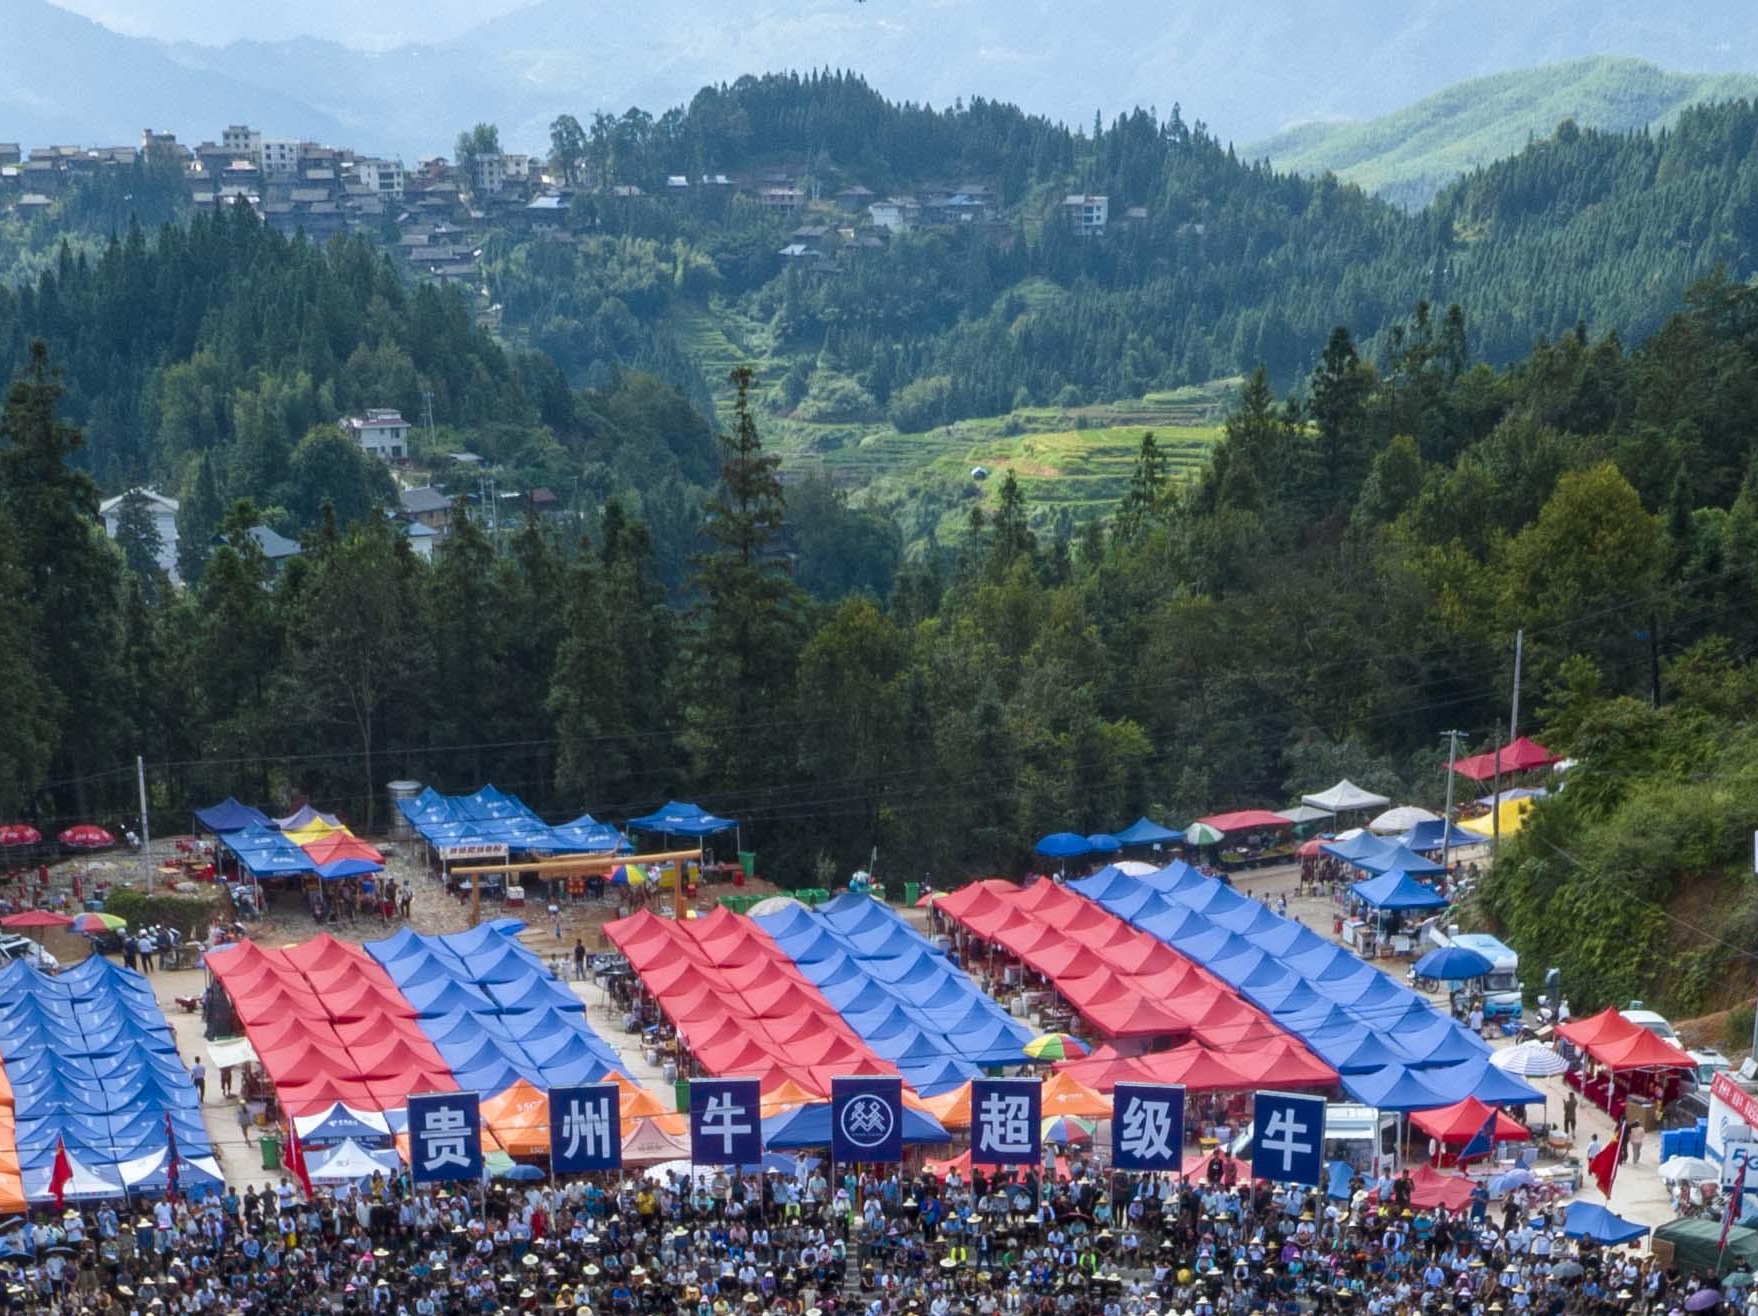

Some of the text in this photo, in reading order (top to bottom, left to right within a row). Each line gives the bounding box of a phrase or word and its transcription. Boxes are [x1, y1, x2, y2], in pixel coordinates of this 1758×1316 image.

[420, 1093, 1313, 1172] 贵州牛 超级牛
